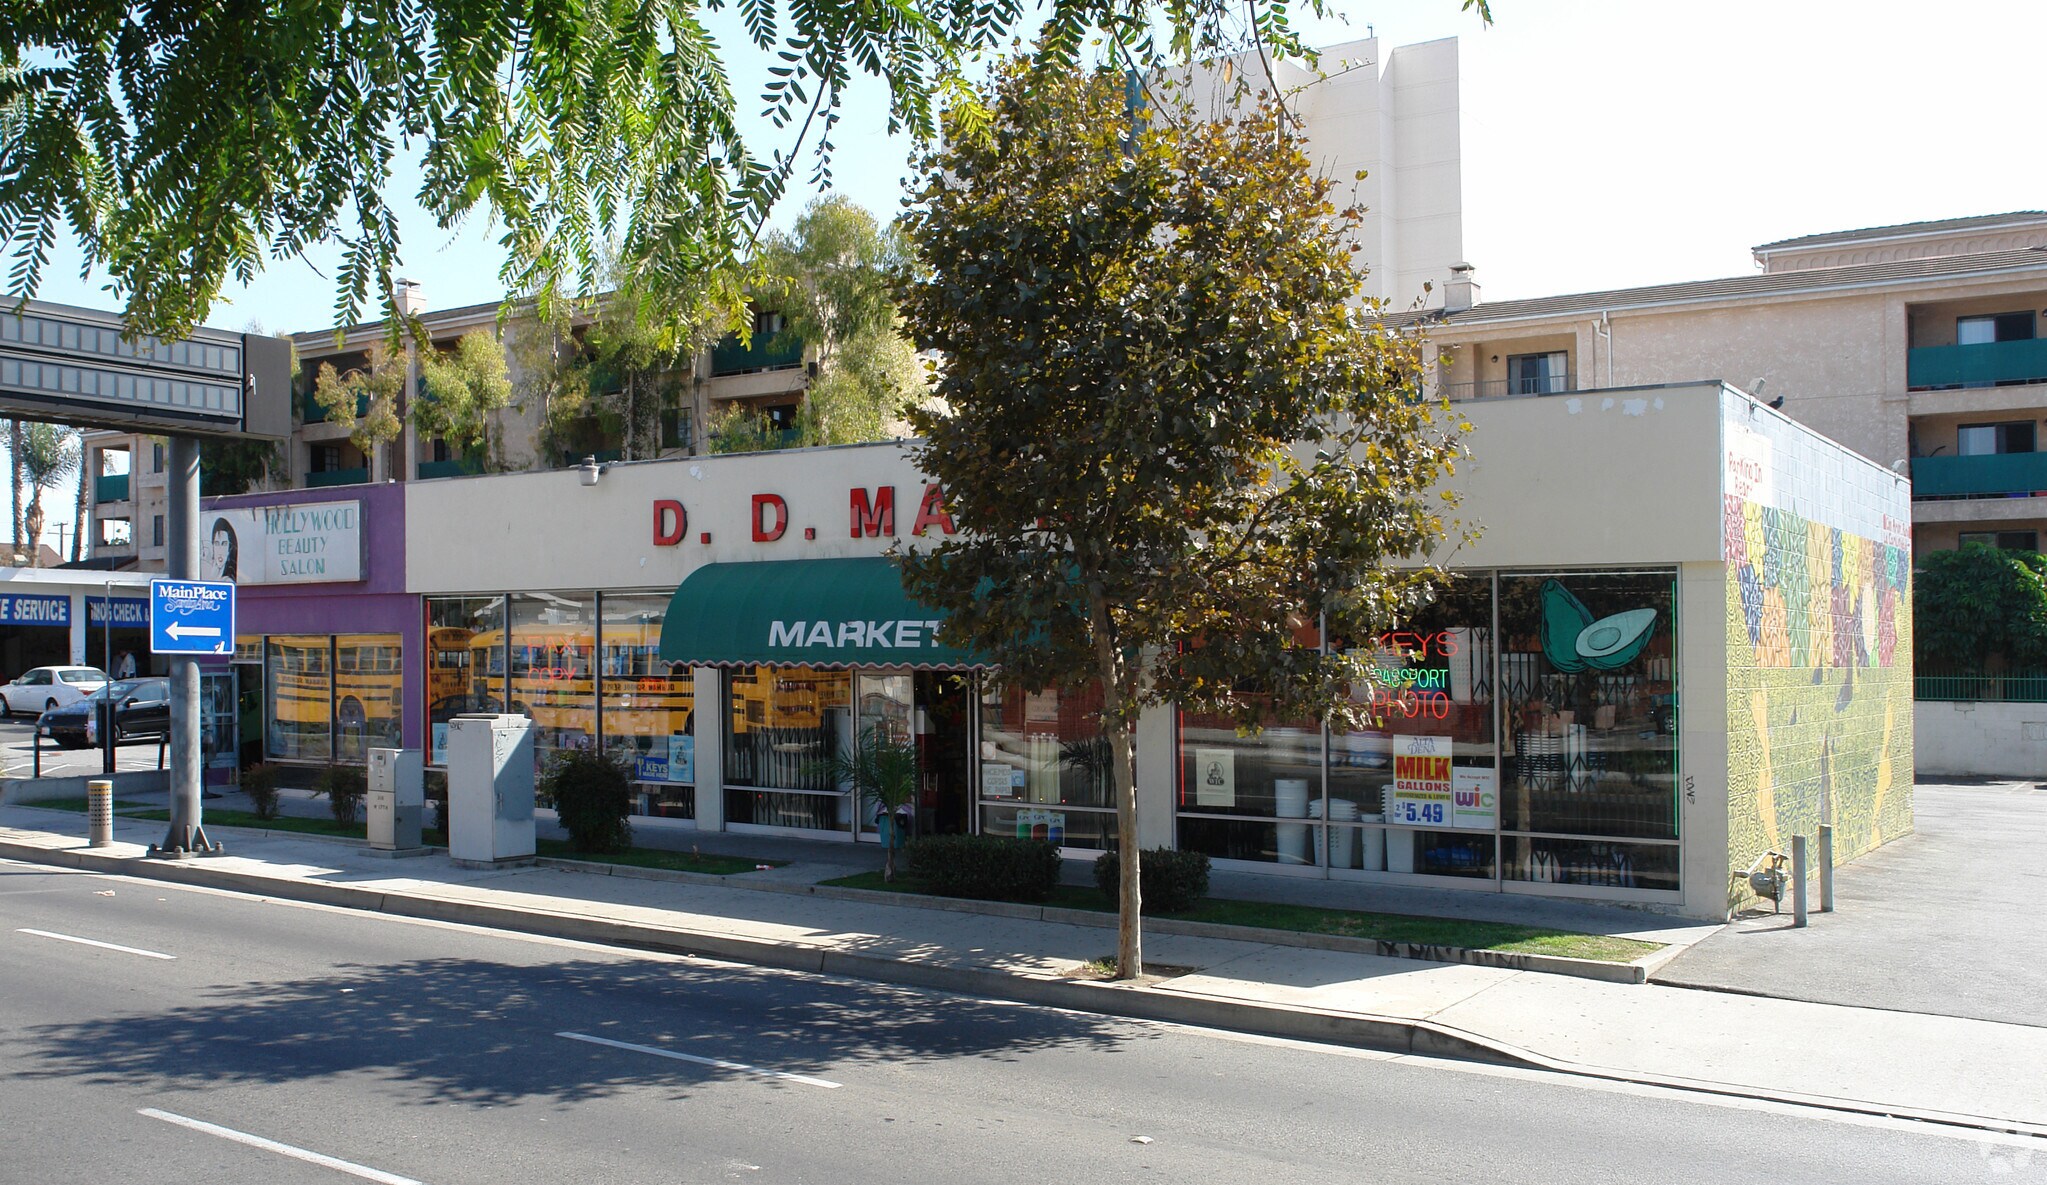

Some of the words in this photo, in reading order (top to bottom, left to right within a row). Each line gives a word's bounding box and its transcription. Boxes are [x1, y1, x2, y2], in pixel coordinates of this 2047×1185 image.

[265, 508, 355, 535] HOLLYWOOD
[653, 499, 711, 547] D.
[751, 493, 816, 543] D.
[278, 536, 328, 555] BEAUTY
[280, 558, 326, 576] SALON
[158, 585, 228, 600] MainPlace
[13, 599, 67, 621] SERVICE
[114, 603, 143, 622] CHECK
[768, 620, 941, 649] MARKET
[527, 635, 575, 654] FAX
[527, 666, 577, 685] COPY
[1372, 690, 1449, 719] PHOTO
[1411, 737, 1435, 747] ALTA
[646, 762, 668, 773] KEYS
[1395, 756, 1450, 782] MILK
[1397, 781, 1450, 792] GALLONS
